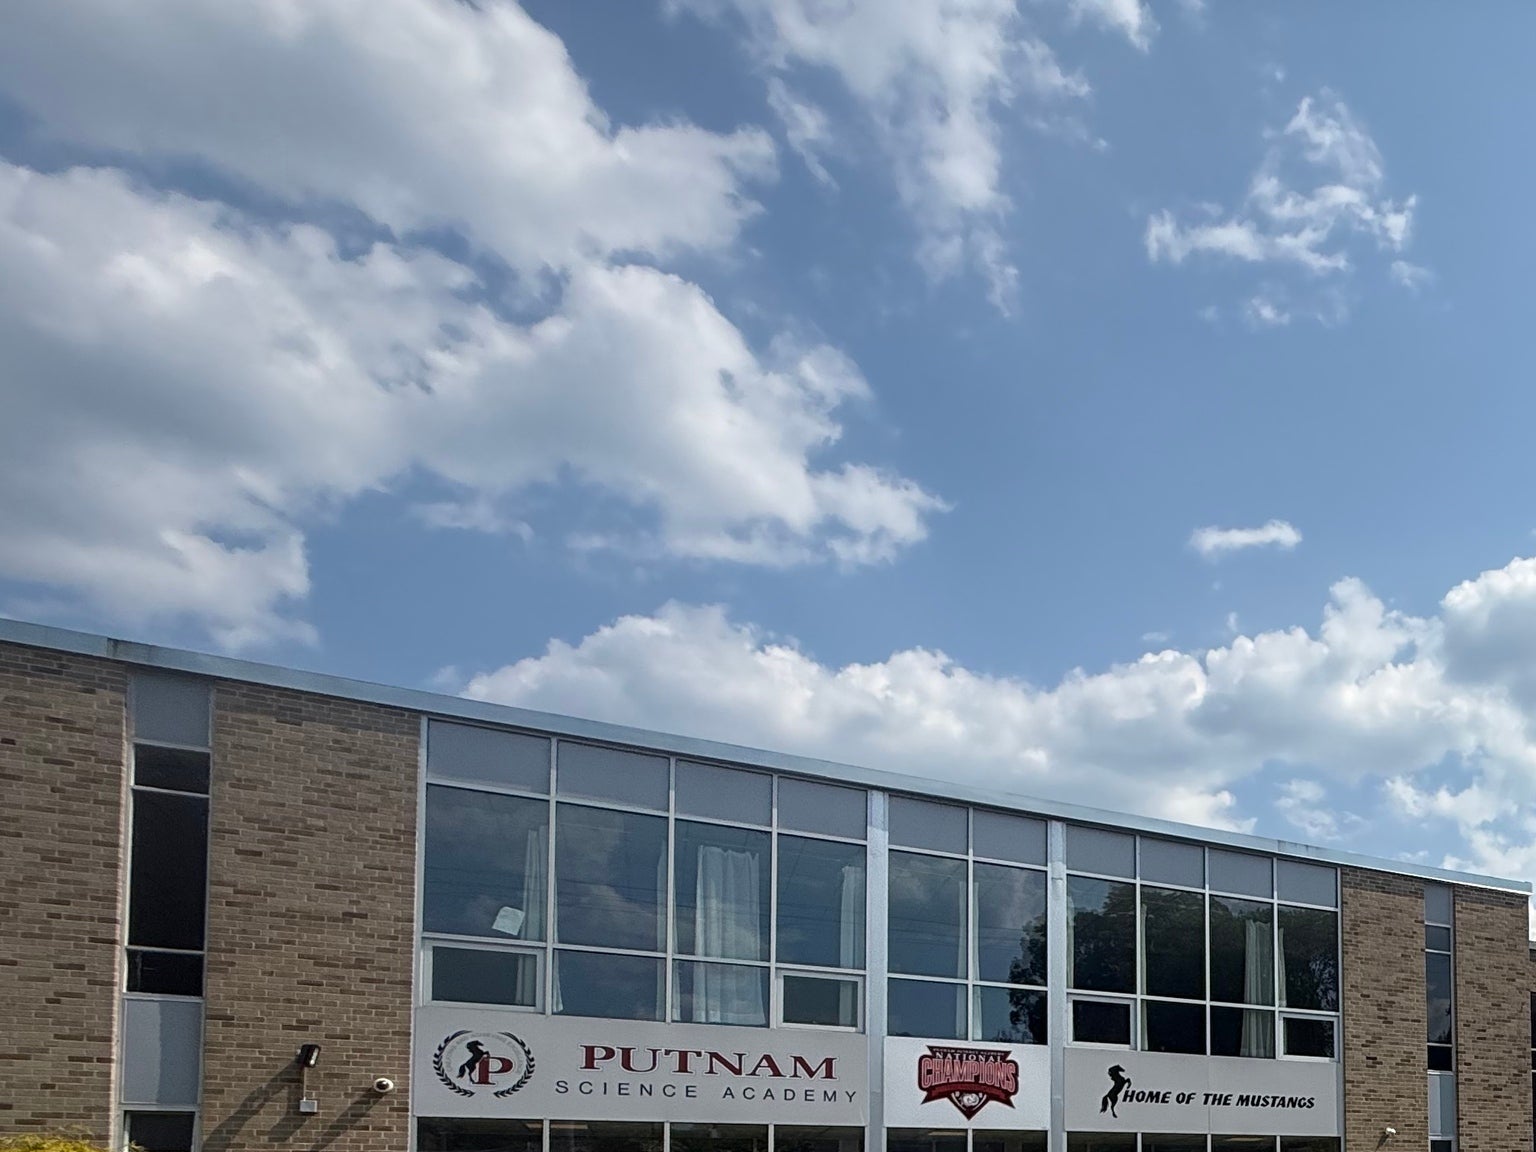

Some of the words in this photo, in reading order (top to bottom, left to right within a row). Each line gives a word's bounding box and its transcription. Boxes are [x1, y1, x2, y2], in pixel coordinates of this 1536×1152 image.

[579, 1044, 838, 1080] PUTNAM
[935, 1052, 1003, 1063] NATIONAL
[921, 1057, 1016, 1093] CHAMPIONS
[555, 1080, 698, 1099] SCIENCE
[722, 1086, 857, 1104] ACADEMY
[1122, 1089, 1172, 1104] HOME
[1176, 1092, 1197, 1105] OF
[1203, 1092, 1233, 1106] THE
[1236, 1094, 1316, 1109] MUSTANGS
